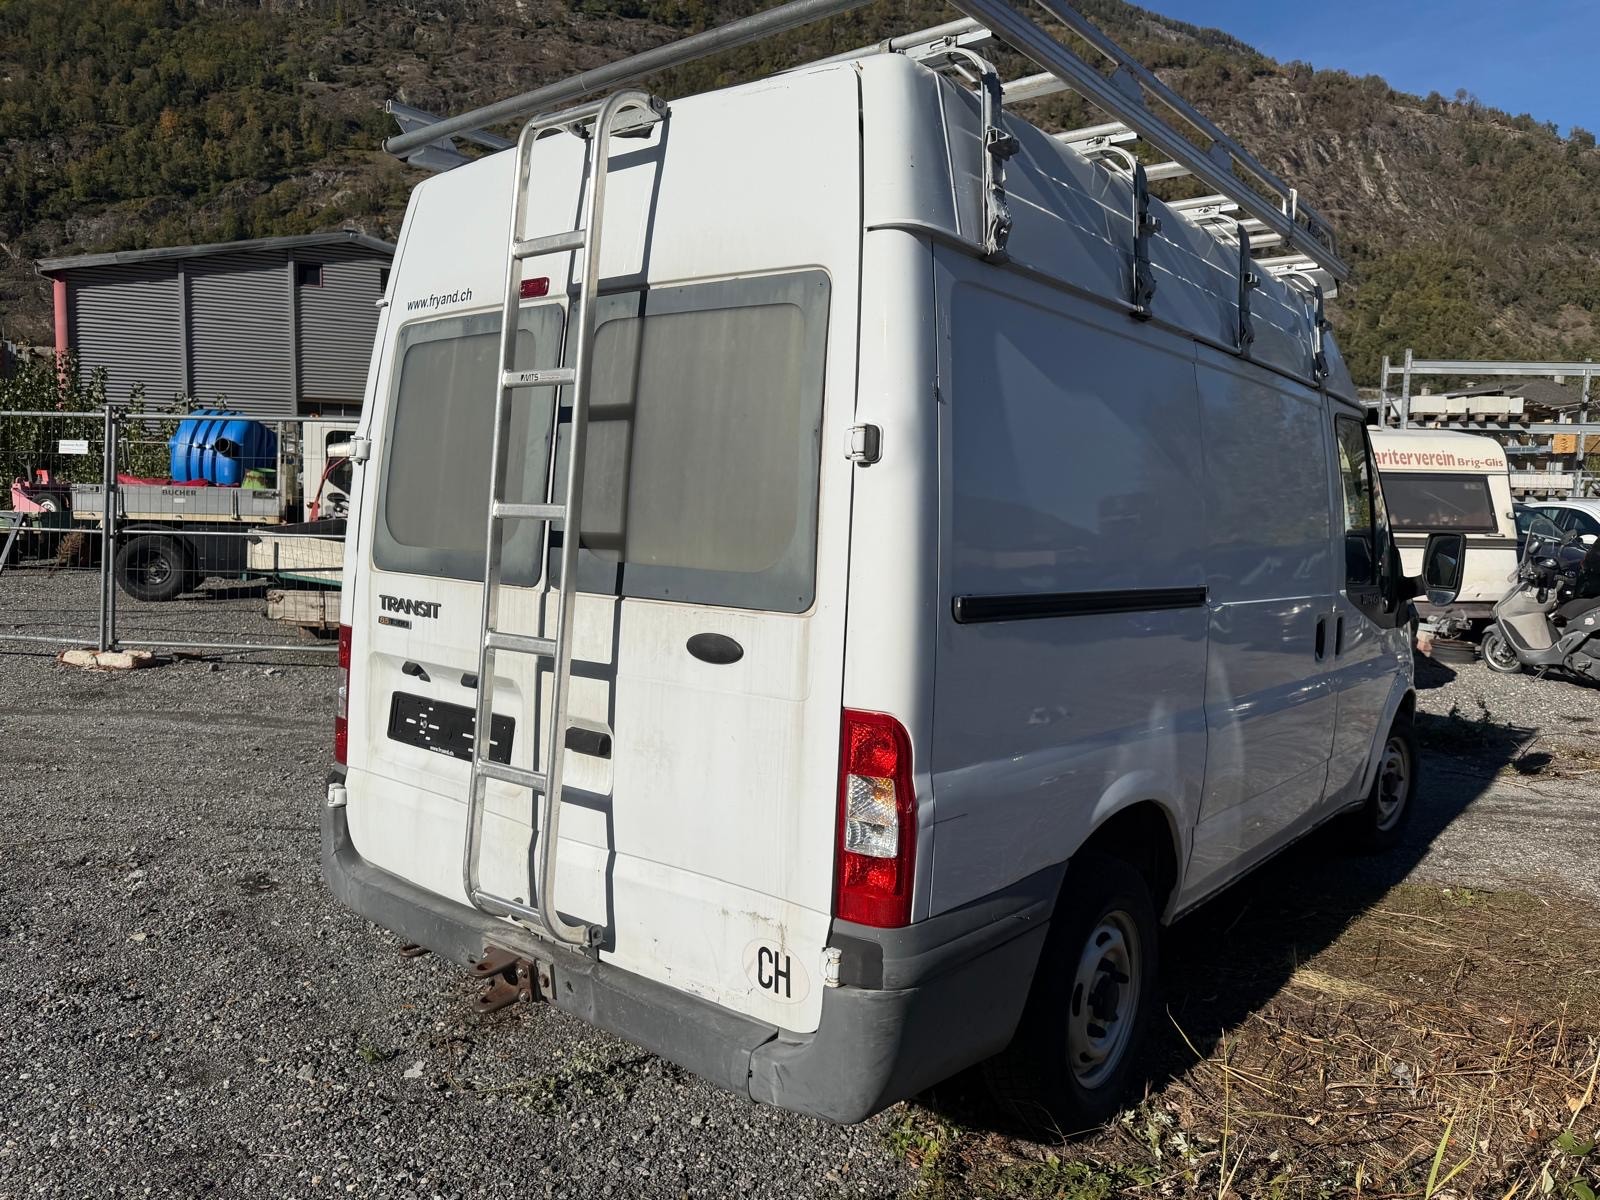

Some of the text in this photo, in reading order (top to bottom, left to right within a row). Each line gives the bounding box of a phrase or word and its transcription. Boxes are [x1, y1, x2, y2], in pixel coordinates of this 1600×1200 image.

[407, 287, 472, 311] www.fryand.ch
[1375, 449, 1504, 469] ariterverein Brig-Glis
[162, 489, 197, 497] BUCHER
[378, 594, 442, 619] TRANSIT
[757, 946, 791, 999] CH
